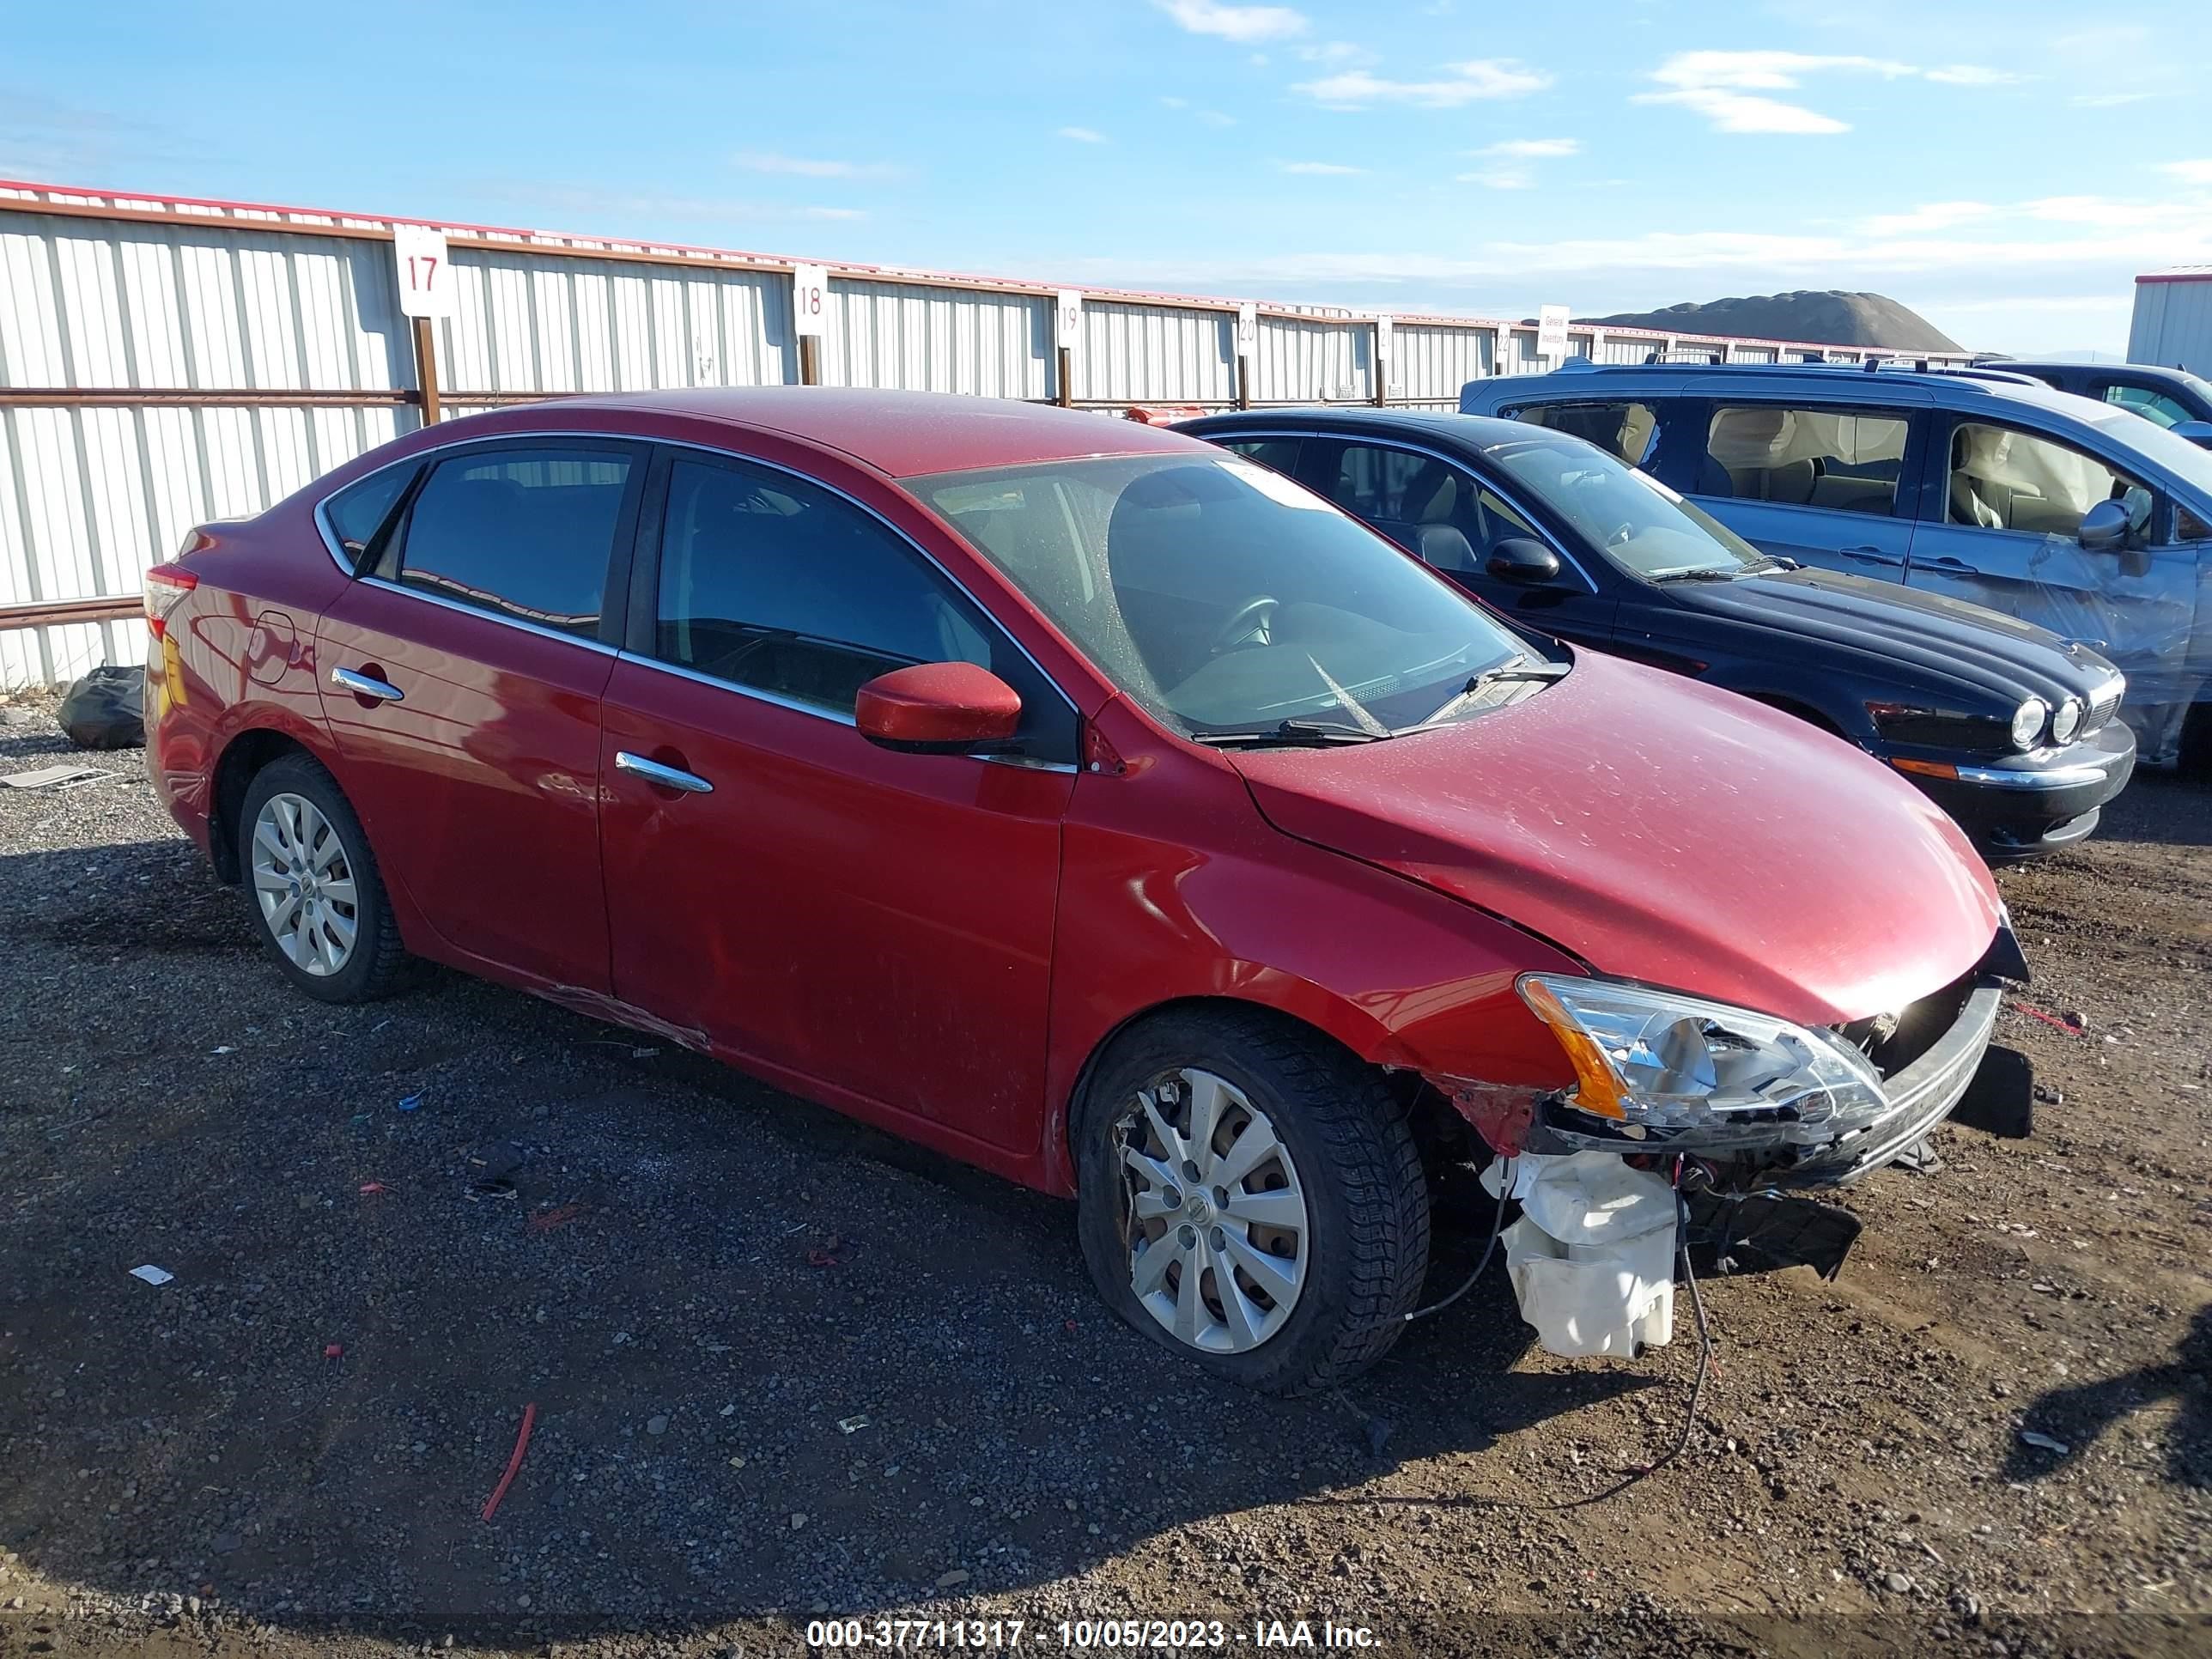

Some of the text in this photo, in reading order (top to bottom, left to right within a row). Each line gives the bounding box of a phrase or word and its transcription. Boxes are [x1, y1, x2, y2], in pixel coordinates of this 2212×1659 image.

[408, 256, 437, 290] 17
[802, 287, 821, 315] 18
[1063, 307, 1077, 331] 19
[1240, 319, 1254, 341] 20
[1546, 316, 1565, 326] General
[1381, 328, 1390, 347] 21
[1498, 334, 1509, 351] 22
